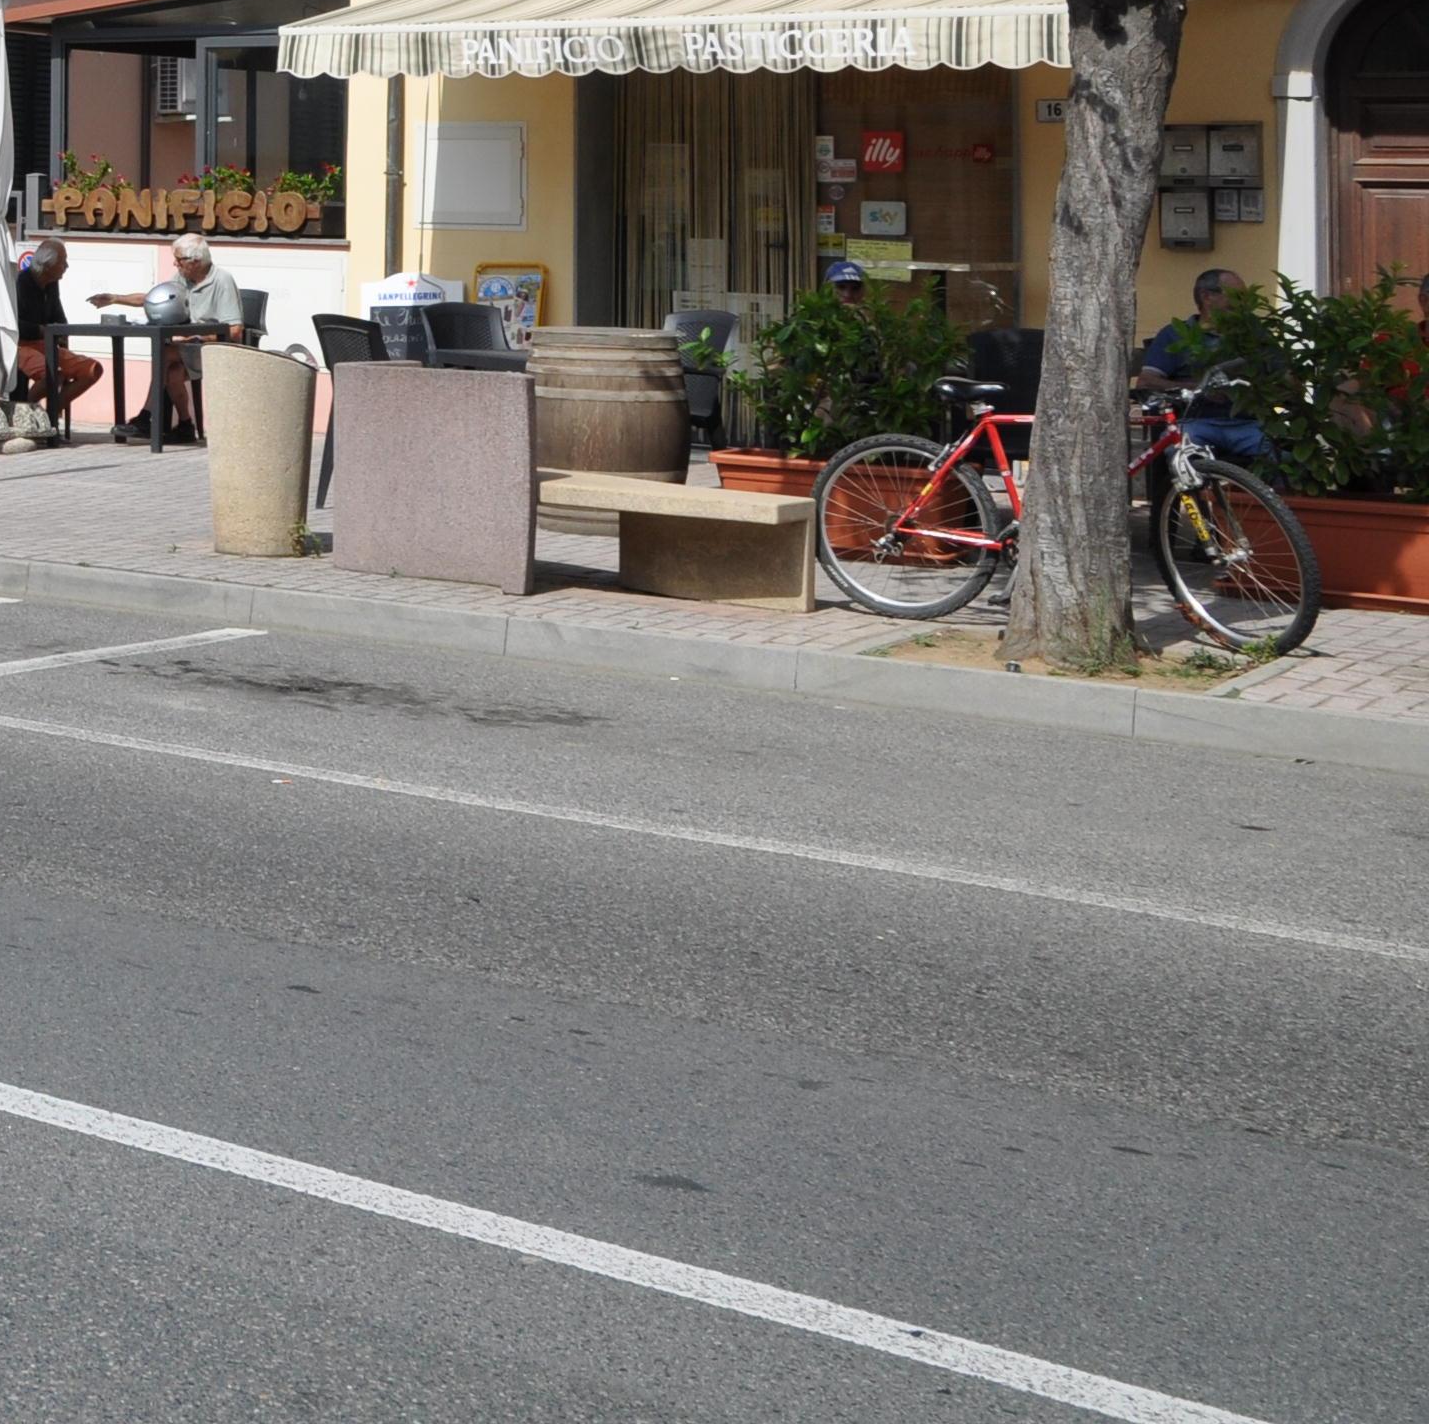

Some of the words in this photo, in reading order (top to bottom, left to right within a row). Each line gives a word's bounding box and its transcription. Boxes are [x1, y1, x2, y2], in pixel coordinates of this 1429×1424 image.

[460, 35, 625, 66] PANIFICIO
[682, 26, 917, 63] PASTICCERIA
[1045, 103, 1062, 117] 16
[864, 138, 902, 168] illy
[52, 188, 307, 233] PANIFICIO
